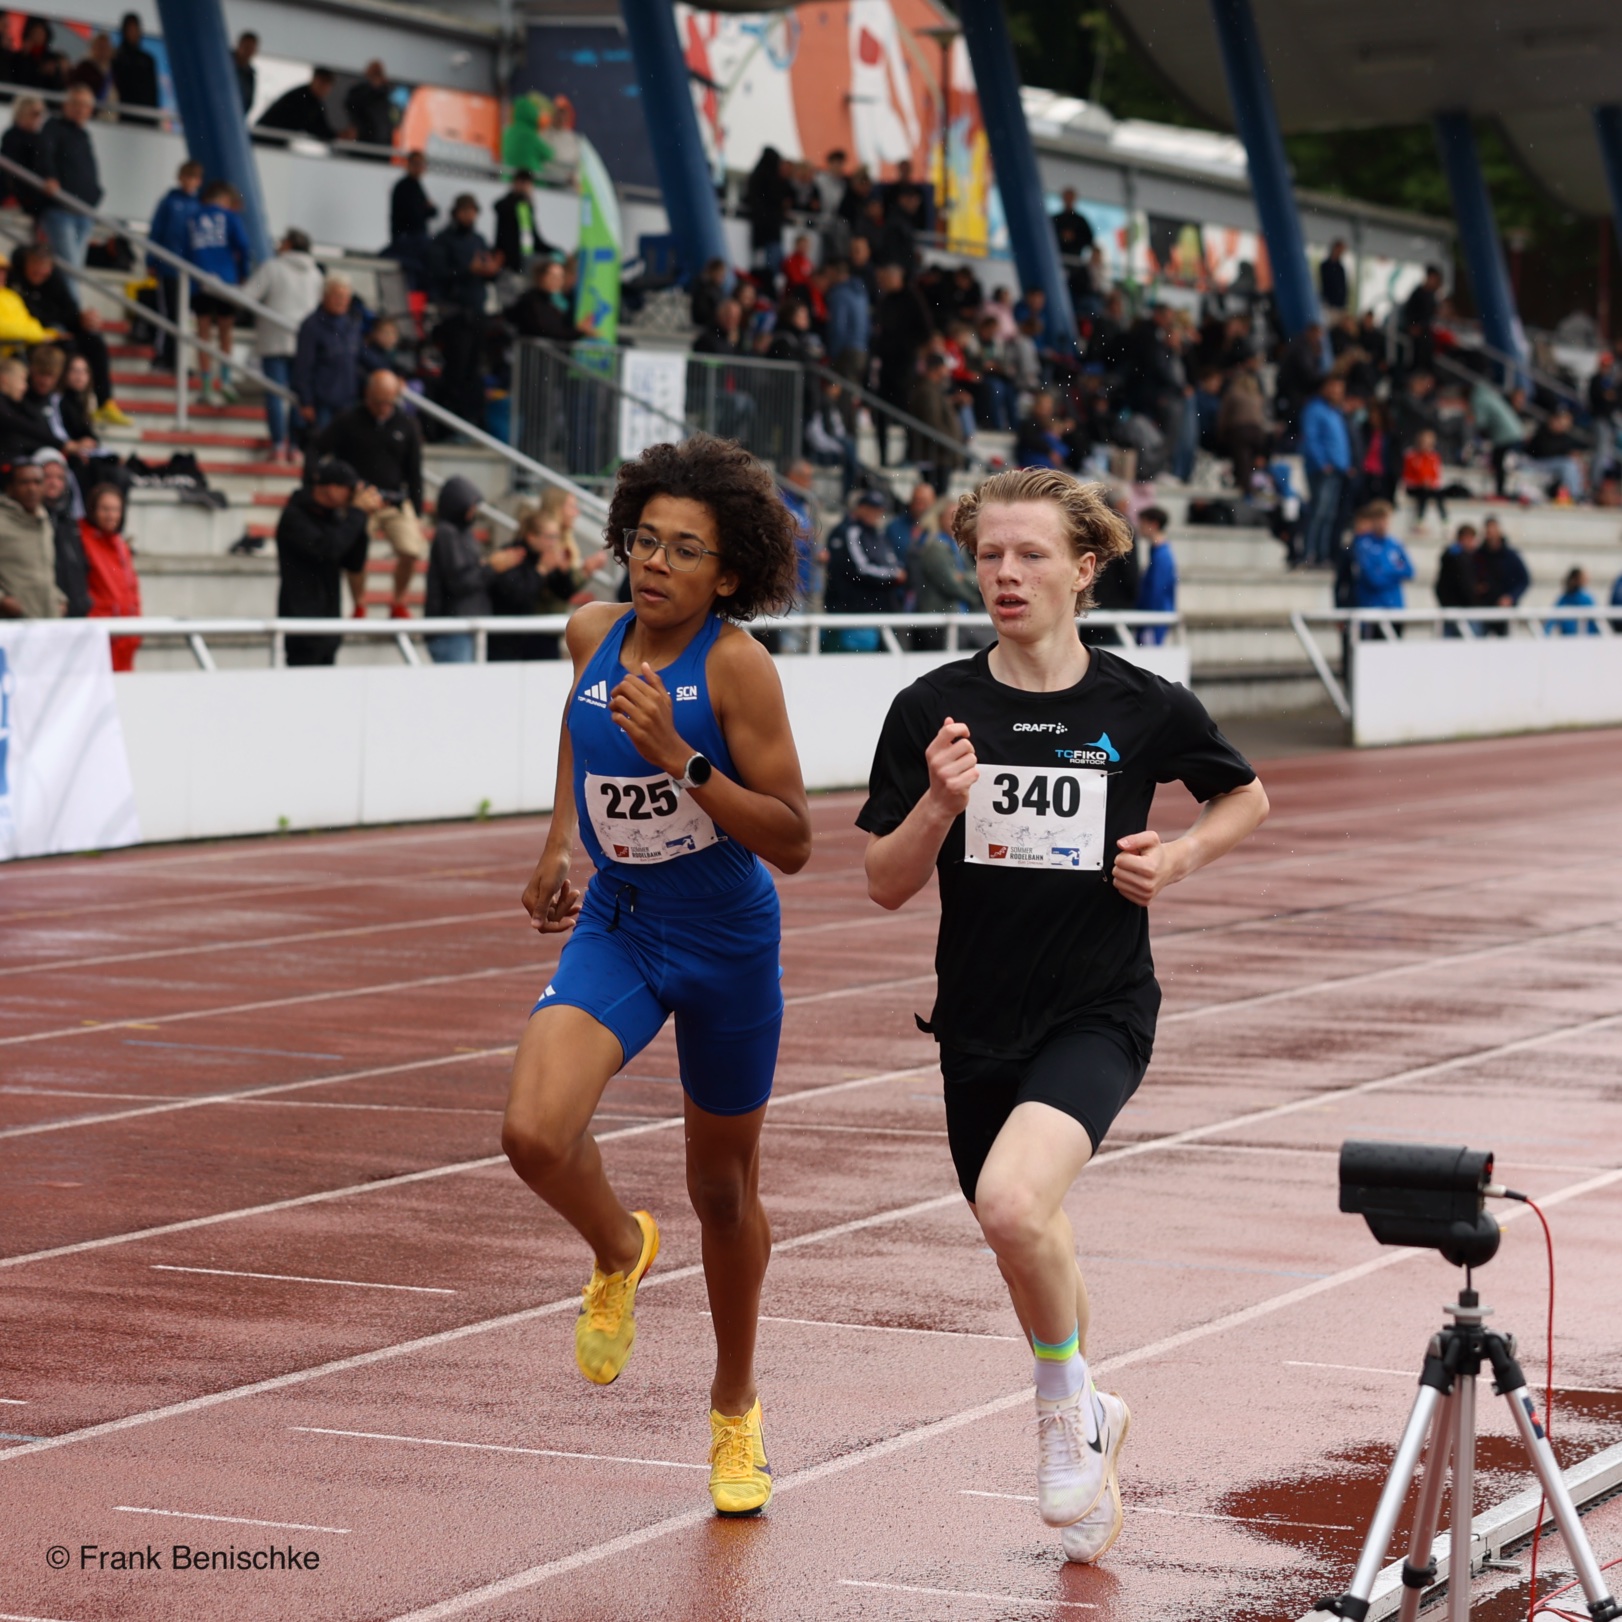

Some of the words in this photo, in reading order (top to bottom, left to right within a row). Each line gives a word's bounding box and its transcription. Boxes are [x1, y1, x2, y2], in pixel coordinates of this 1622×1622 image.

[676, 685, 698, 697] SCN
[1012, 723, 1056, 732] CRAFT
[1055, 749, 1107, 760] TCFIKO
[600, 779, 678, 820] 225
[992, 772, 1081, 818] 340
[1010, 846, 1033, 854] SOMMER
[1009, 853, 1044, 861] RODELBAHN
